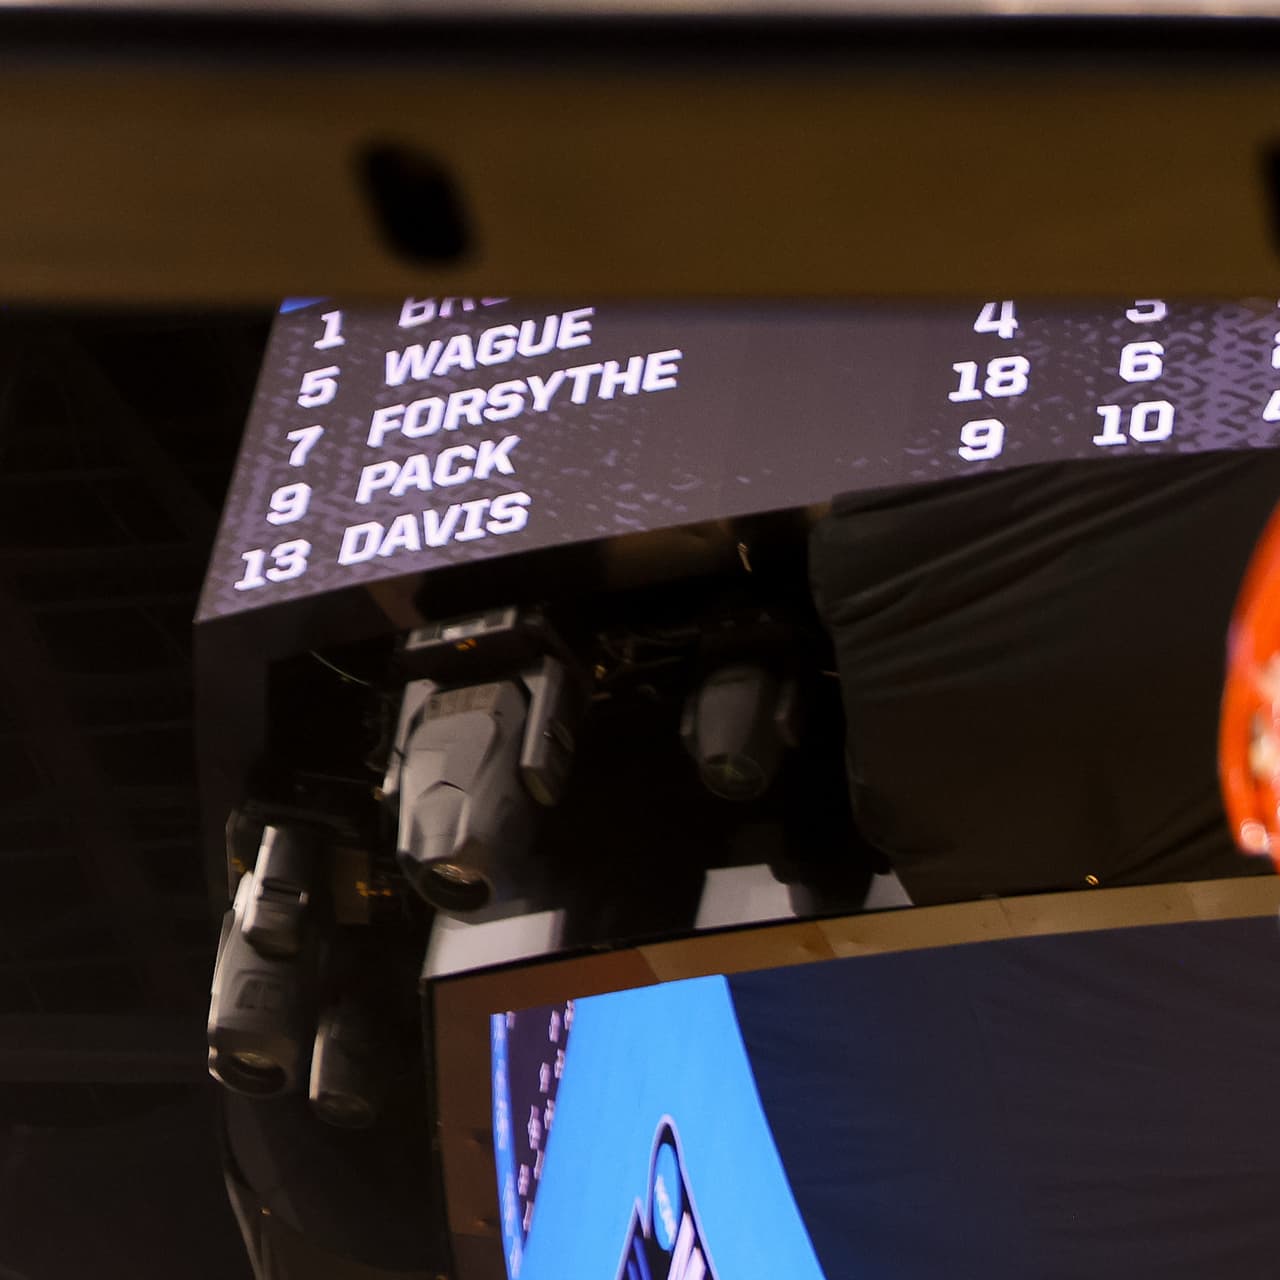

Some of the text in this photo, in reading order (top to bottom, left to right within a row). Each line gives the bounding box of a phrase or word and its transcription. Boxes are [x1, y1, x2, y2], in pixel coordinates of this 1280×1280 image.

[286, 300, 1021, 466] 7 FORSYTHE 4
[297, 366, 341, 408] 5
[385, 307, 595, 387] WAGUE
[313, 310, 346, 350] 1
[234, 538, 312, 591] 13
[337, 491, 532, 566] DAVIS
[958, 418, 1006, 461] 9
[1092, 400, 1176, 446] 10
[266, 483, 314, 526] 9
[355, 435, 521, 503] PACK
[948, 355, 1032, 403] 18
[1119, 340, 1165, 383] 6
